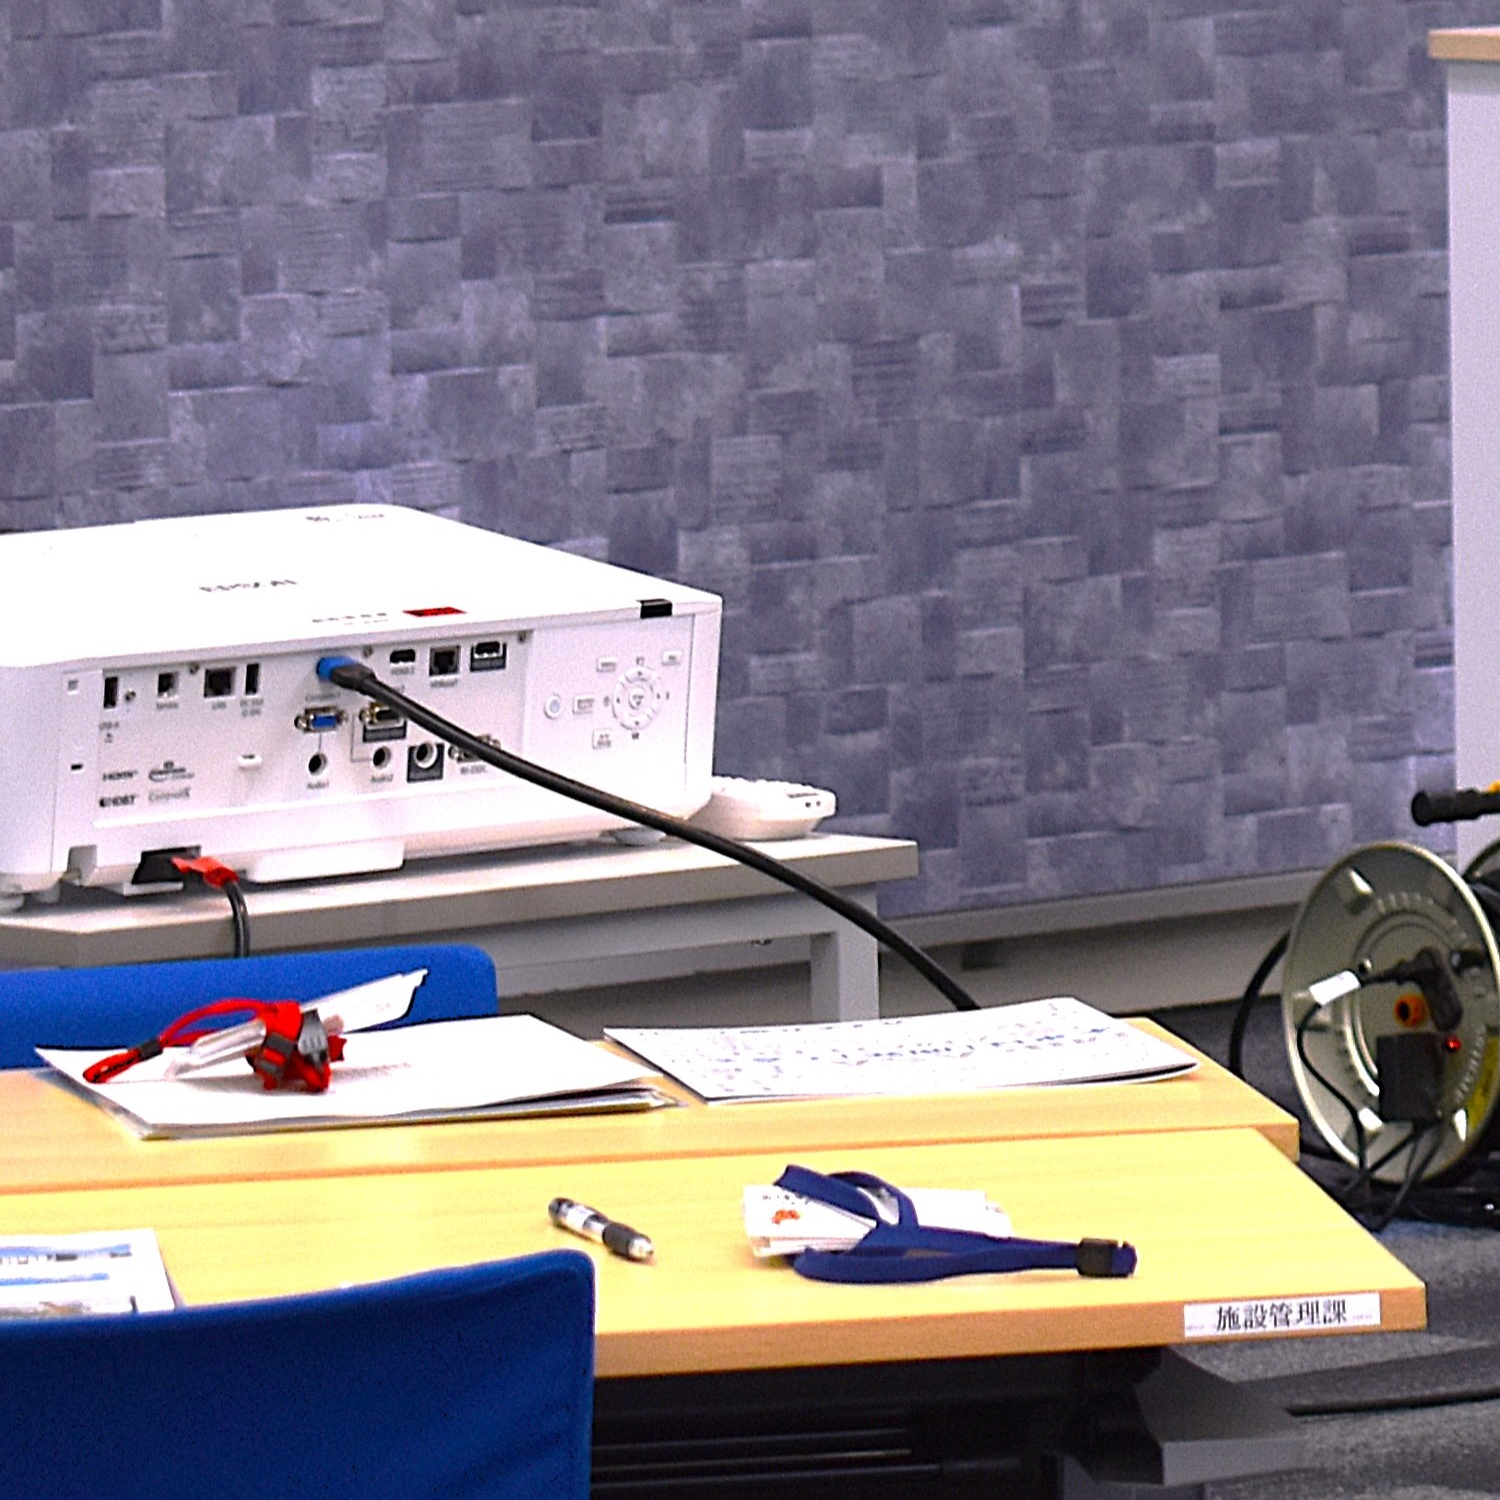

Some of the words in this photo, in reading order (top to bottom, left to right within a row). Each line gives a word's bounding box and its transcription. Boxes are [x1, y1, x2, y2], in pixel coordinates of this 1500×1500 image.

[1216, 1298, 1348, 1332] 施設管理課
